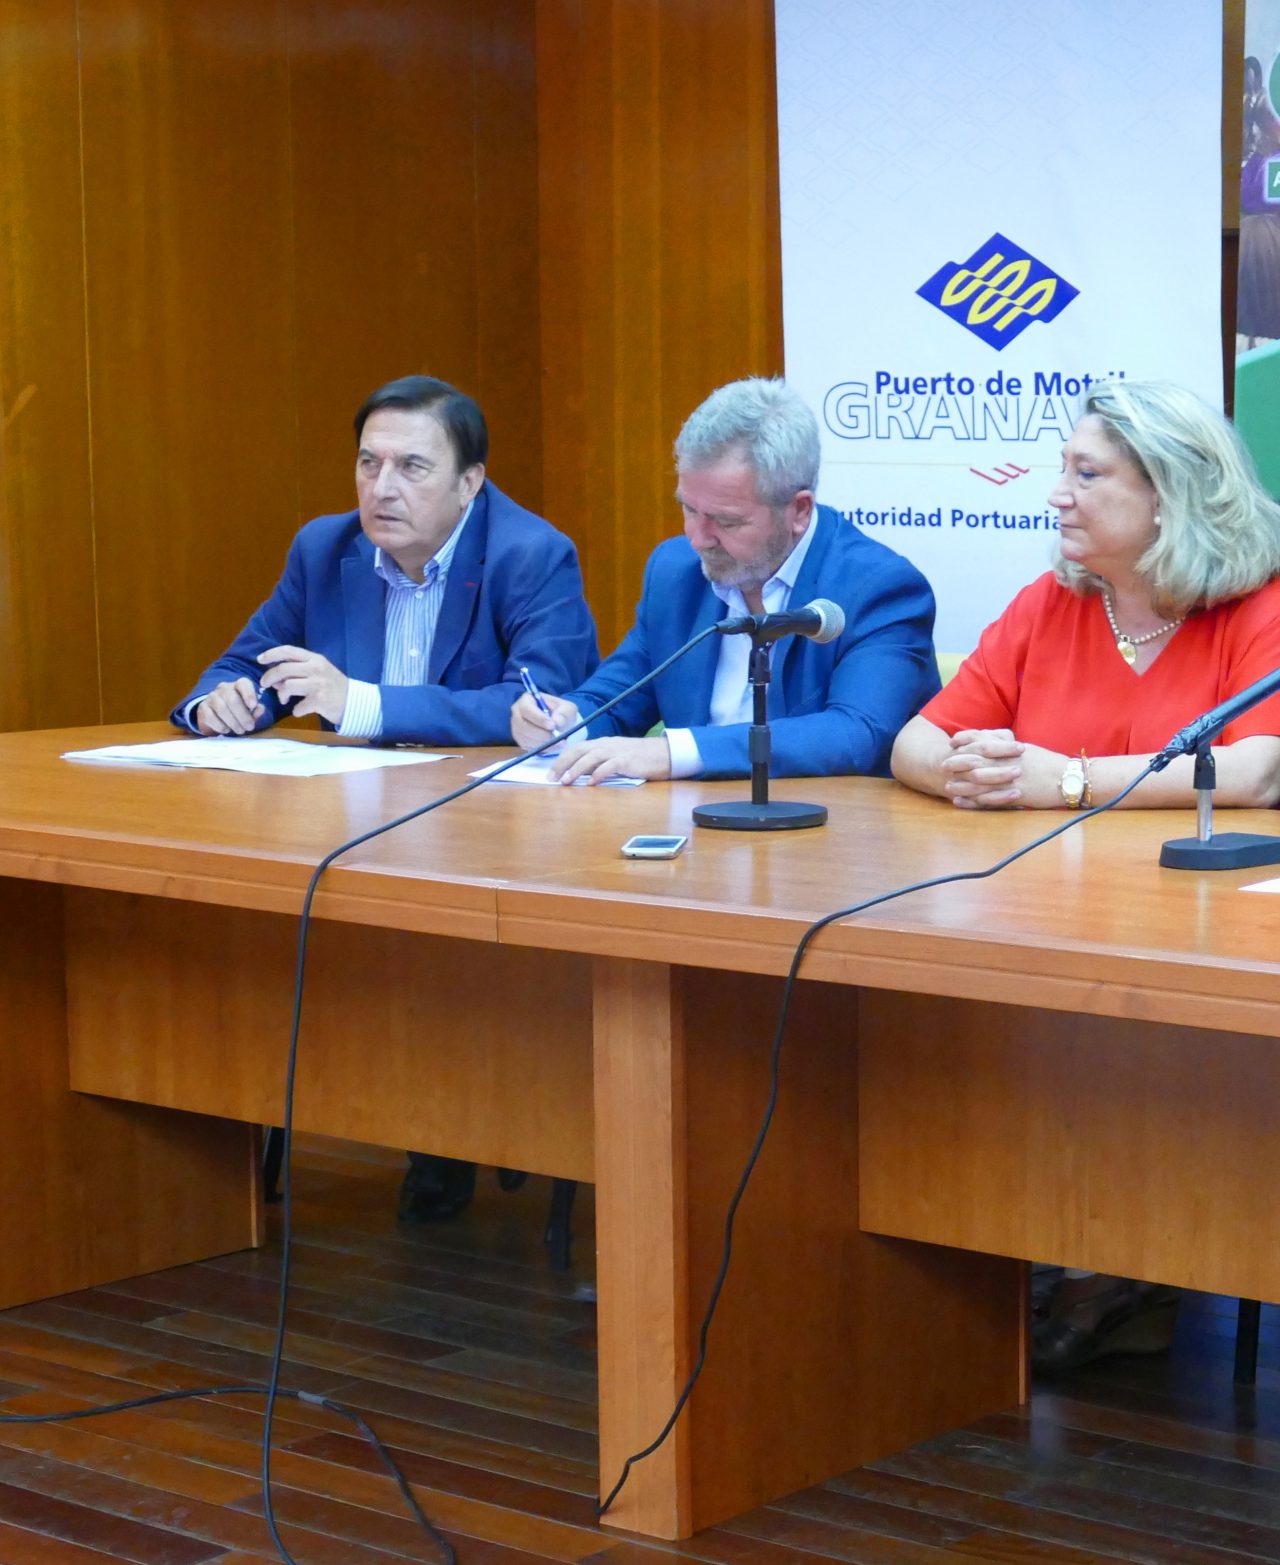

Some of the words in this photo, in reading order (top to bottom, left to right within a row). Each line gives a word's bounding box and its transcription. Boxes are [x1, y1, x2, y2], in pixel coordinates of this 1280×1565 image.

[875, 370, 975, 395] Puerto
[985, 369, 1022, 396] de
[1034, 370, 1125, 396] Mot
[823, 381, 1076, 442] GRANA
